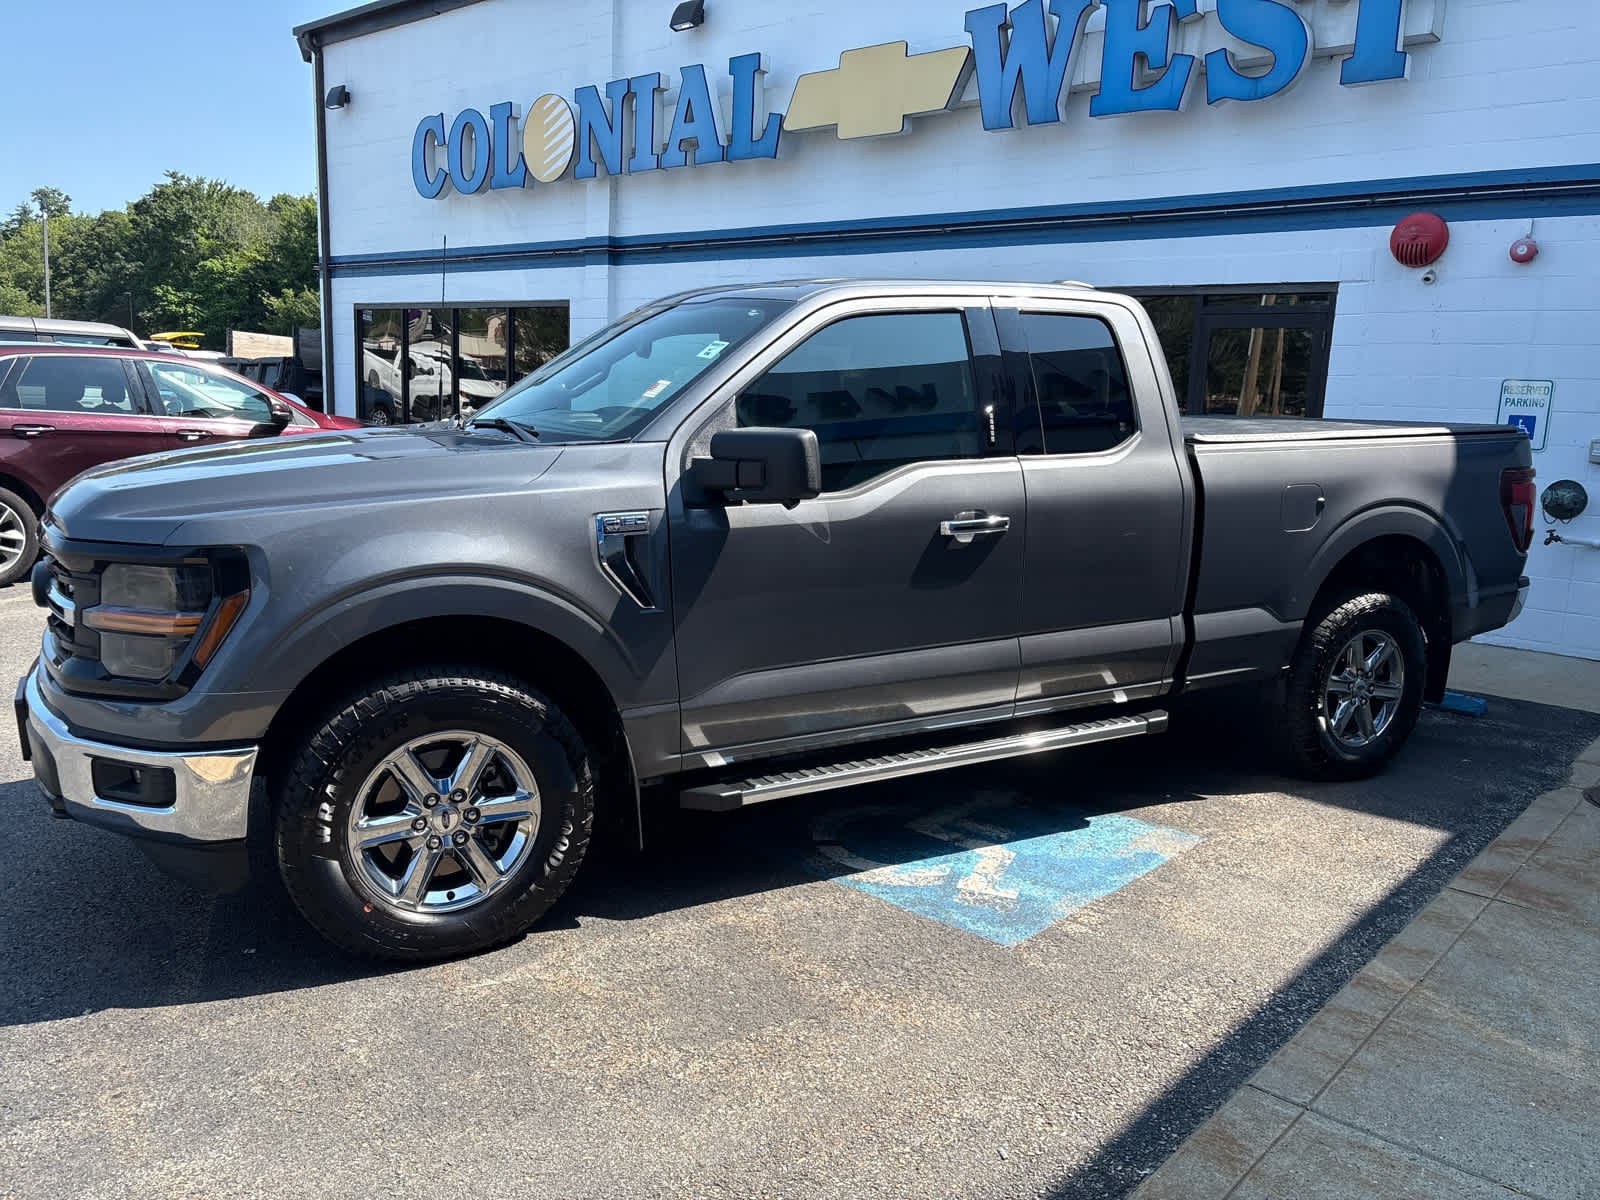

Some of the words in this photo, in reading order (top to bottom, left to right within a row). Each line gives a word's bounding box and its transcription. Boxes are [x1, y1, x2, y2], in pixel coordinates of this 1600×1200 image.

[412, 52, 782, 199] COLONIAL
[1503, 385, 1550, 395] RESERVED
[1504, 397, 1545, 408] PARKING
